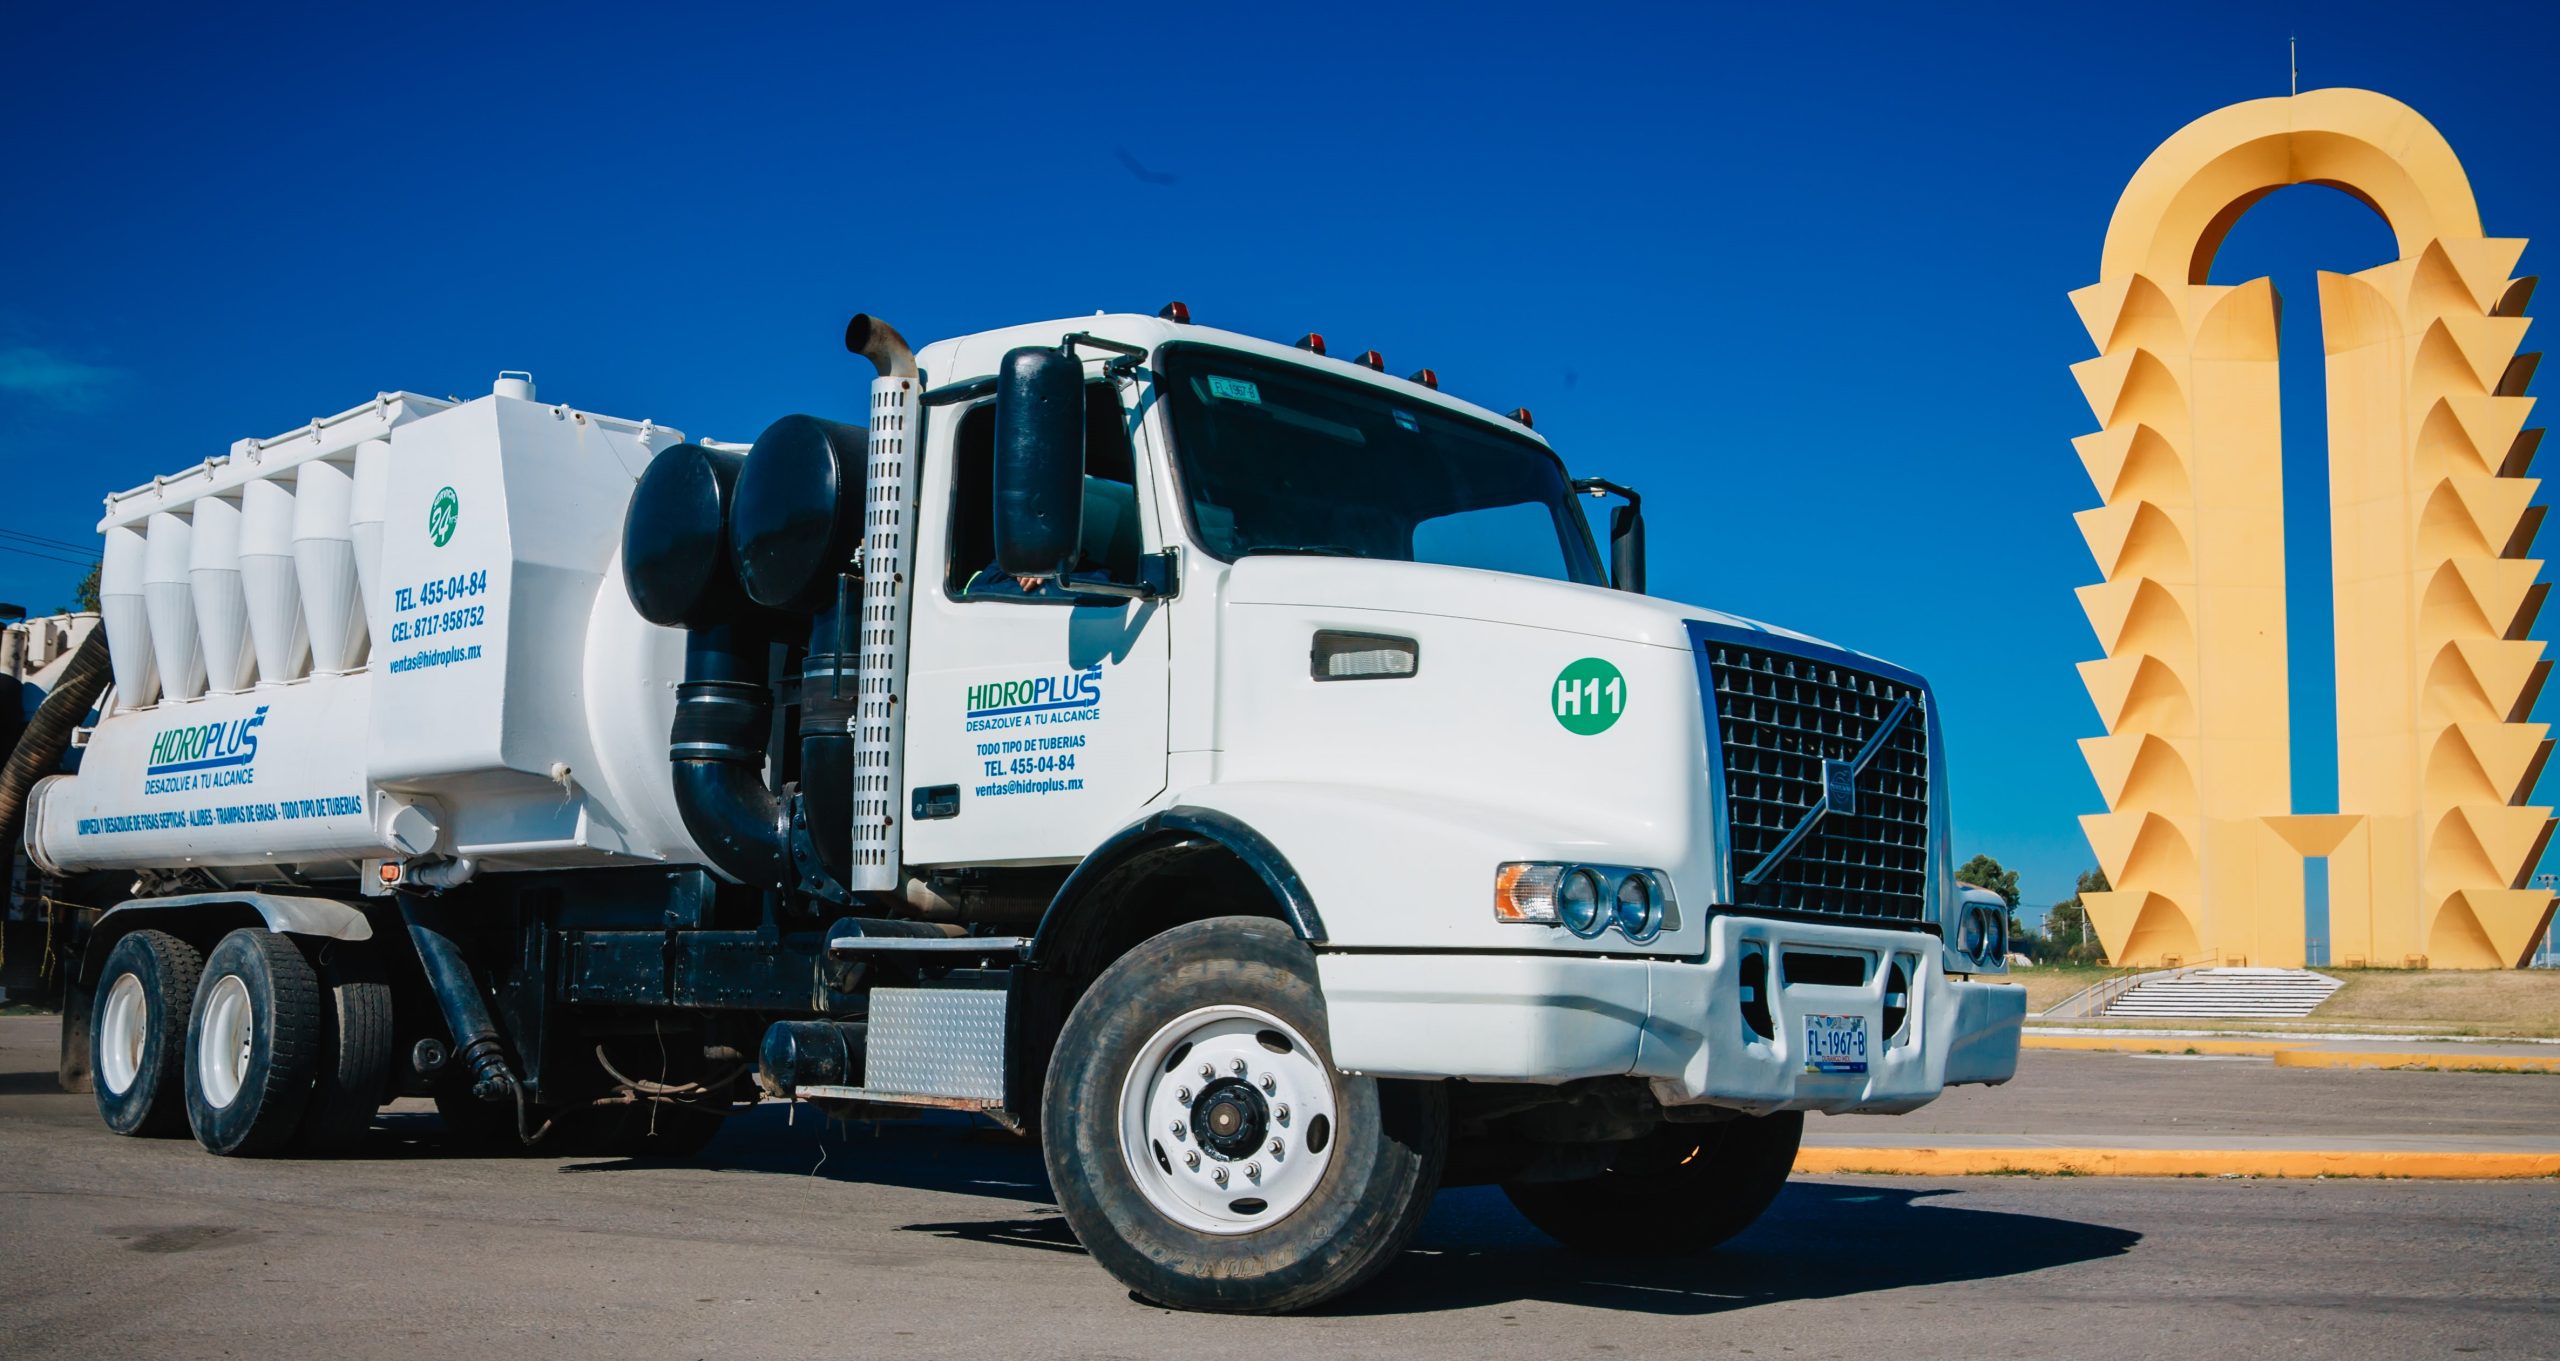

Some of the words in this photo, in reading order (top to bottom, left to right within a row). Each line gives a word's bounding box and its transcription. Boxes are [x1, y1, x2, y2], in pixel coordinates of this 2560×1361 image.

[395, 587, 417, 612] TEL.
[420, 569, 487, 606] 455-04-84
[392, 621, 412, 643] CEL:
[414, 605, 485, 638] 8717-958752
[390, 644, 482, 674] ventas@hidroplus.mx
[968, 664, 1102, 711] HIDROPLUS
[1557, 676, 1621, 716] H11
[966, 716, 1022, 732] DESAZOLVE
[1025, 715, 1031, 726] A
[1035, 713, 1048, 725] TU
[1050, 708, 1100, 724] ALCANCE
[148, 705, 269, 766] HIDROPLUS
[977, 744, 1000, 756] TODO
[1002, 740, 1022, 754] TIPO
[1024, 739, 1037, 751] DE
[1038, 735, 1086, 750] TUBERIAS
[985, 760, 1007, 777] TEL.
[1010, 754, 1075, 775] 455-04-84
[144, 775, 191, 795] DESAZOLVE
[191, 775, 198, 789] A
[201, 773, 213, 789] TU
[213, 768, 254, 788] ALCANCE
[975, 778, 1084, 797] ventas@hidroplus.mx
[132, 815, 141, 831] DE
[159, 809, 187, 829] SEPTICAS
[215, 805, 246, 824] TRAMPAS
[245, 805, 256, 822] DE
[255, 803, 278, 821] GRASA
[280, 801, 300, 819] TODO
[299, 800, 316, 817] TIPO
[315, 799, 327, 816] DE
[325, 796, 362, 815] TUBERIAS
[1808, 1029, 1865, 1056] FL-1967-B
